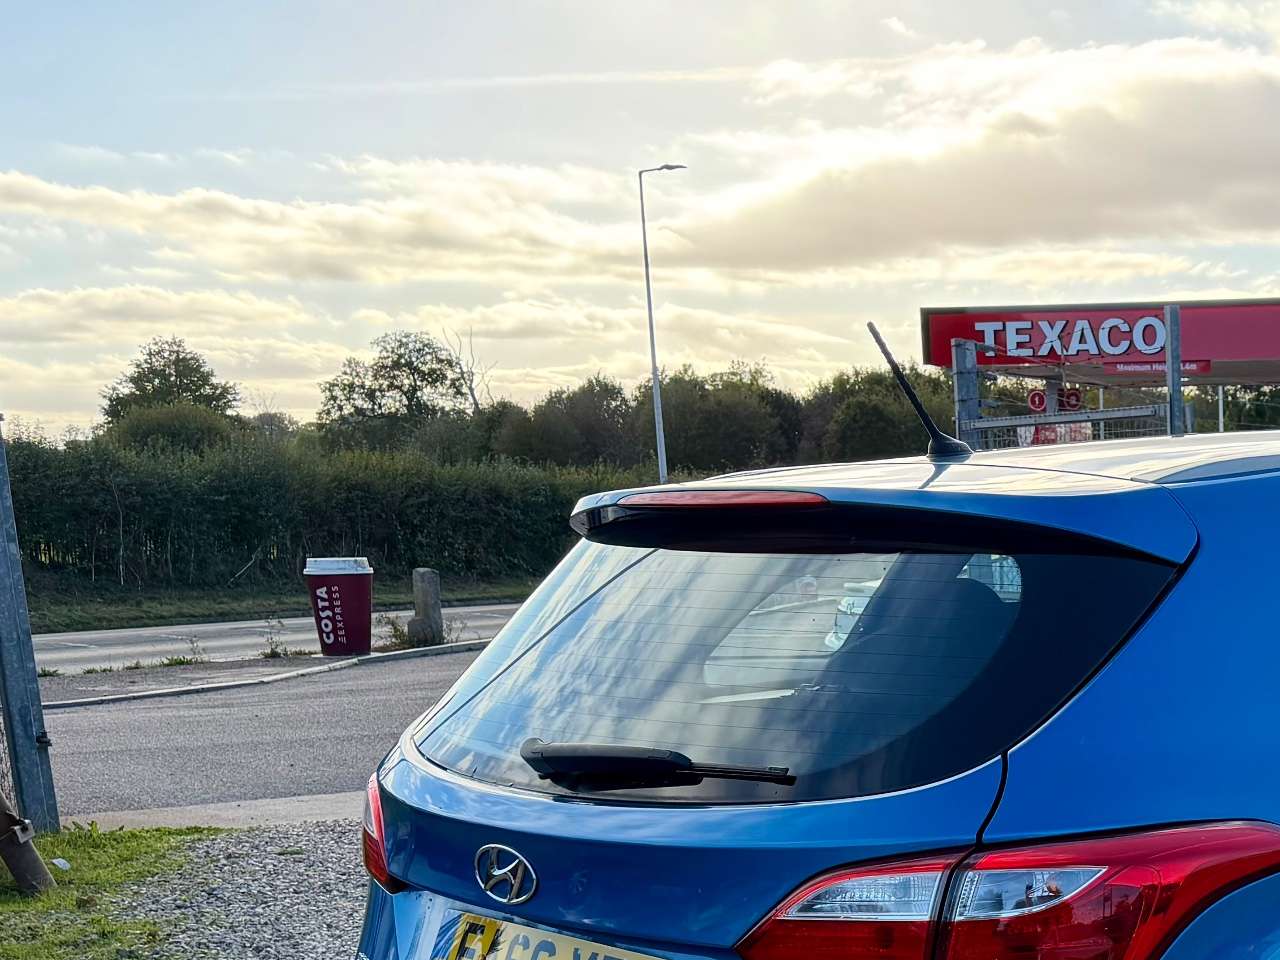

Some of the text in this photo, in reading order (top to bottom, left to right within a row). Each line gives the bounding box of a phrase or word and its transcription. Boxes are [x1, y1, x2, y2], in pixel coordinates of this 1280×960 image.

[974, 316, 1167, 357] TEXACO
[316, 586, 334, 644] COSTA
[331, 585, 345, 635] EXPRESS
